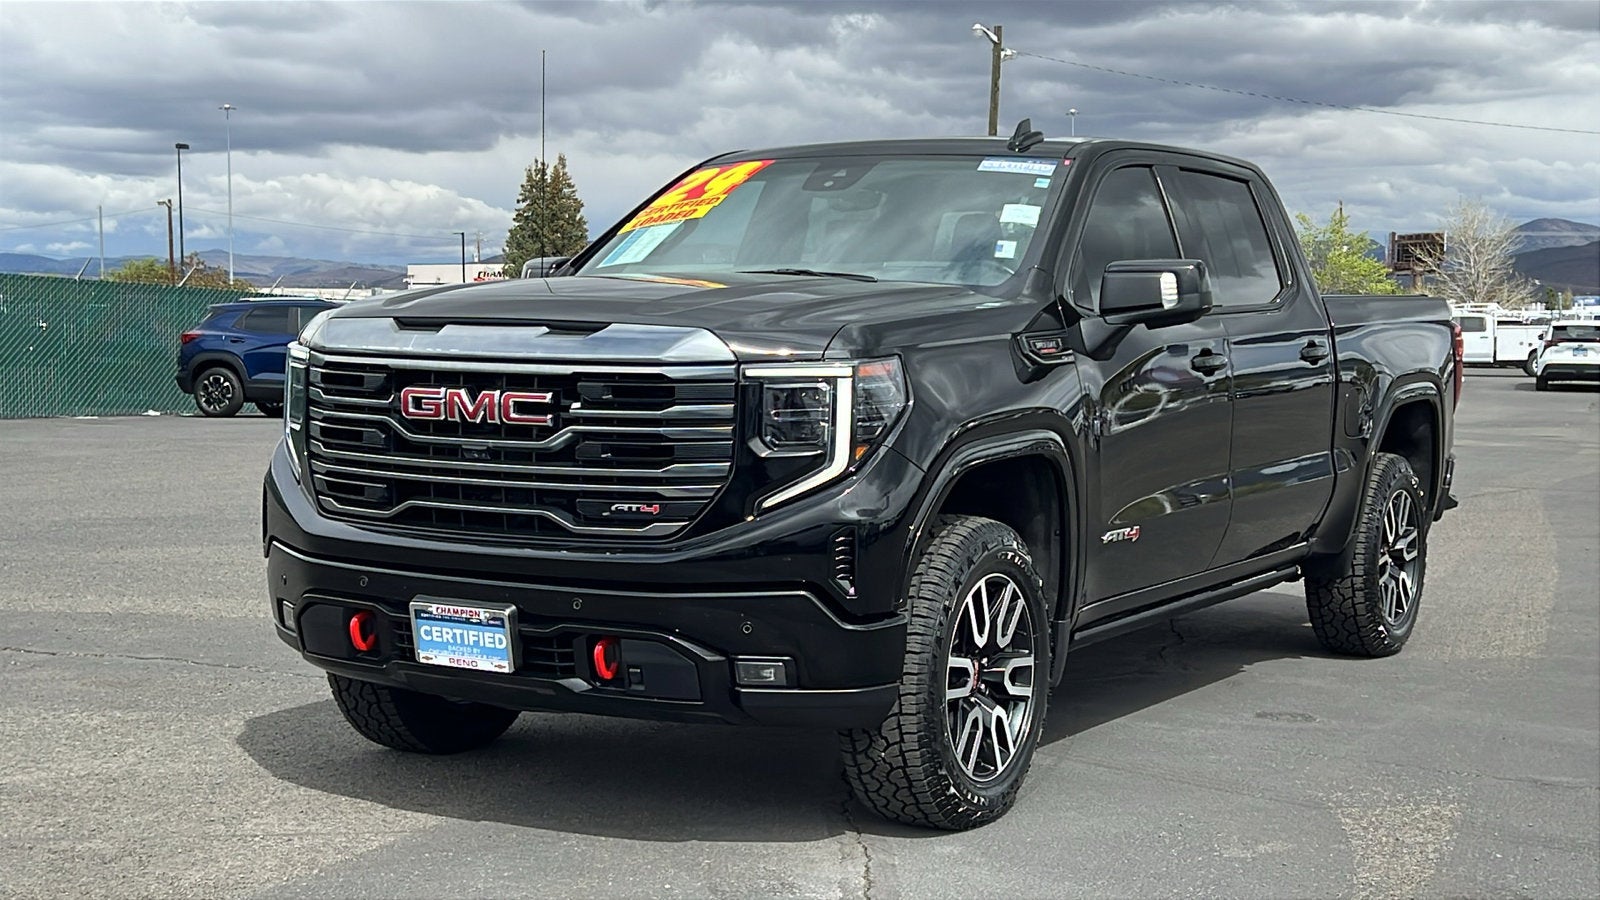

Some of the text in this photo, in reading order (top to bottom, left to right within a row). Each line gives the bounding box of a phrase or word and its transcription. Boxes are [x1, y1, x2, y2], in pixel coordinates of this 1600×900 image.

[649, 161, 763, 208] 24
[632, 209, 698, 228] LOADED
[401, 387, 553, 427] GMC
[602, 504, 660, 515] AT4
[1101, 525, 1140, 543] AT4
[436, 606, 480, 618] CHAMPION
[420, 625, 507, 650] CERTIFIED
[448, 657, 478, 668] RENO
